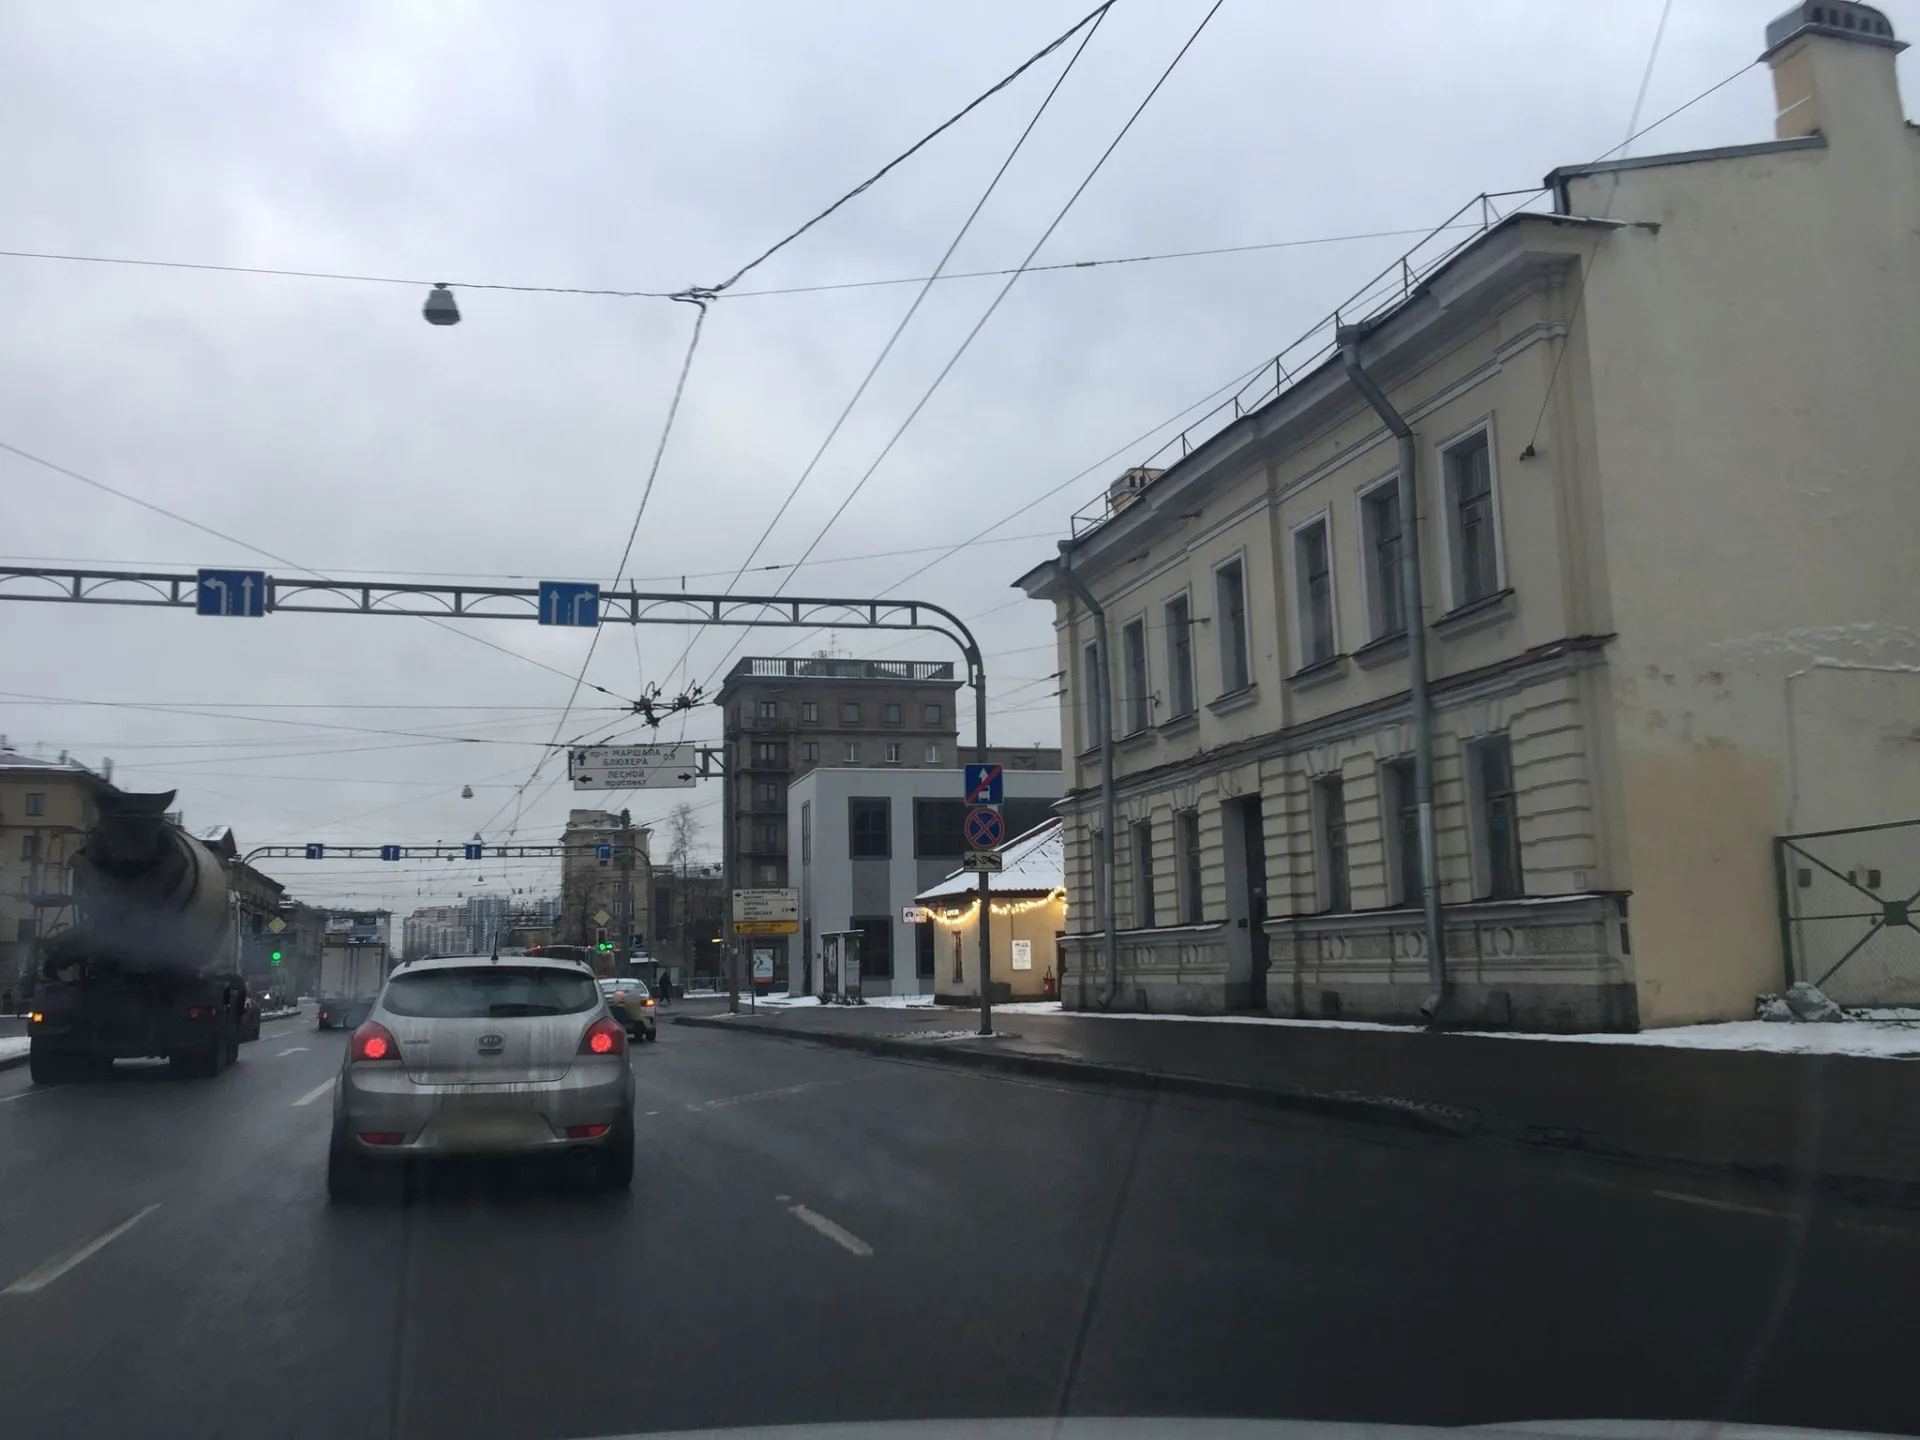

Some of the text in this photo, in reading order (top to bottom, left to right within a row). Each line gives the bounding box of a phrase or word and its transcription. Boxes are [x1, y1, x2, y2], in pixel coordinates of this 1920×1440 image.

[612, 748, 661, 757] МАРШАЛА
[603, 758, 648, 766] БЛЮХЕРА
[608, 769, 645, 778] ЛЕСНОЙ
[605, 778, 648, 787] проспект
